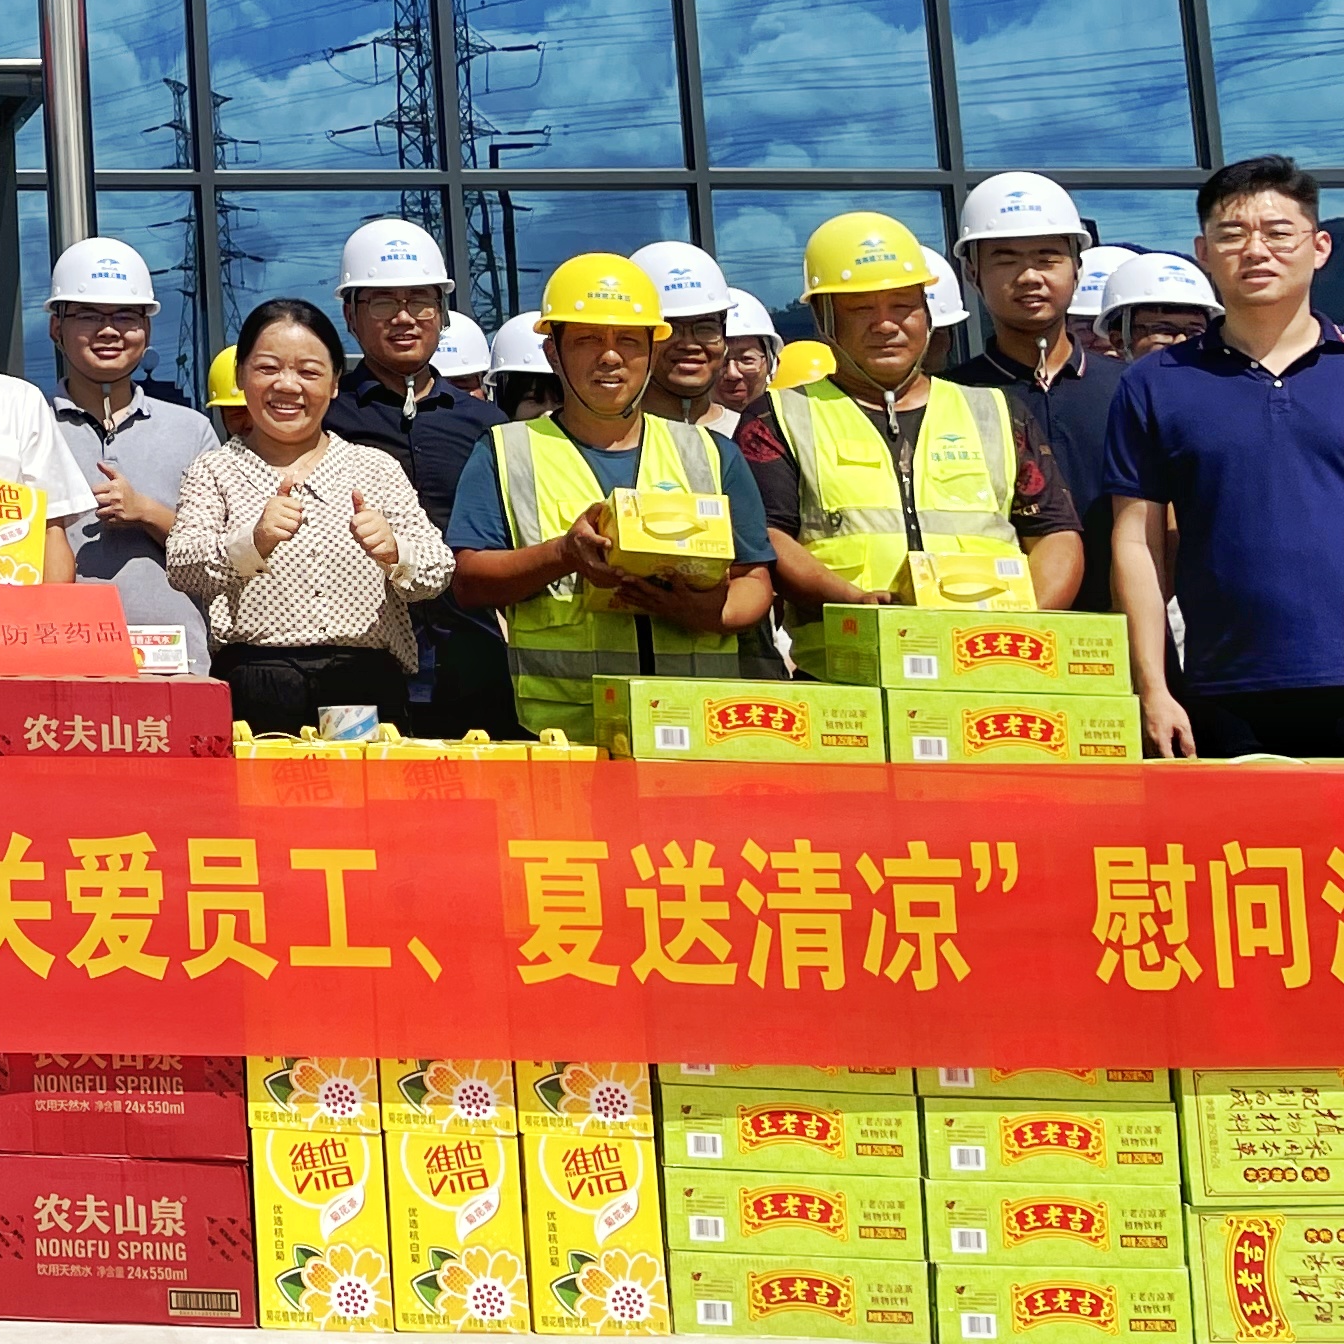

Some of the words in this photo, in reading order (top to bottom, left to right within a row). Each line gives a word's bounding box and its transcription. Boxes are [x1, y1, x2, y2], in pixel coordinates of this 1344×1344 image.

[972, 633, 1035, 659] 王老吉
[726, 704, 797, 729] 王老吉
[24, 714, 171, 752] 农夫山泉
[982, 716, 1046, 742] 王老吉
[34, 1075, 107, 1096] NONGFU
[116, 1076, 184, 1095] SPRING
[759, 1115, 822, 1138] 王老吉
[1023, 1124, 1084, 1148] 王老吉
[34, 1194, 186, 1236] 农夫山泉
[763, 1195, 825, 1219] 王老吉
[1024, 1208, 1087, 1231] 王老吉
[36, 1238, 109, 1258] NONGFU
[118, 1241, 186, 1261] SPRING
[1236, 1240, 1270, 1317] 王老吉
[770, 1279, 834, 1303] 王老吉
[1033, 1291, 1096, 1314] 王老吉
